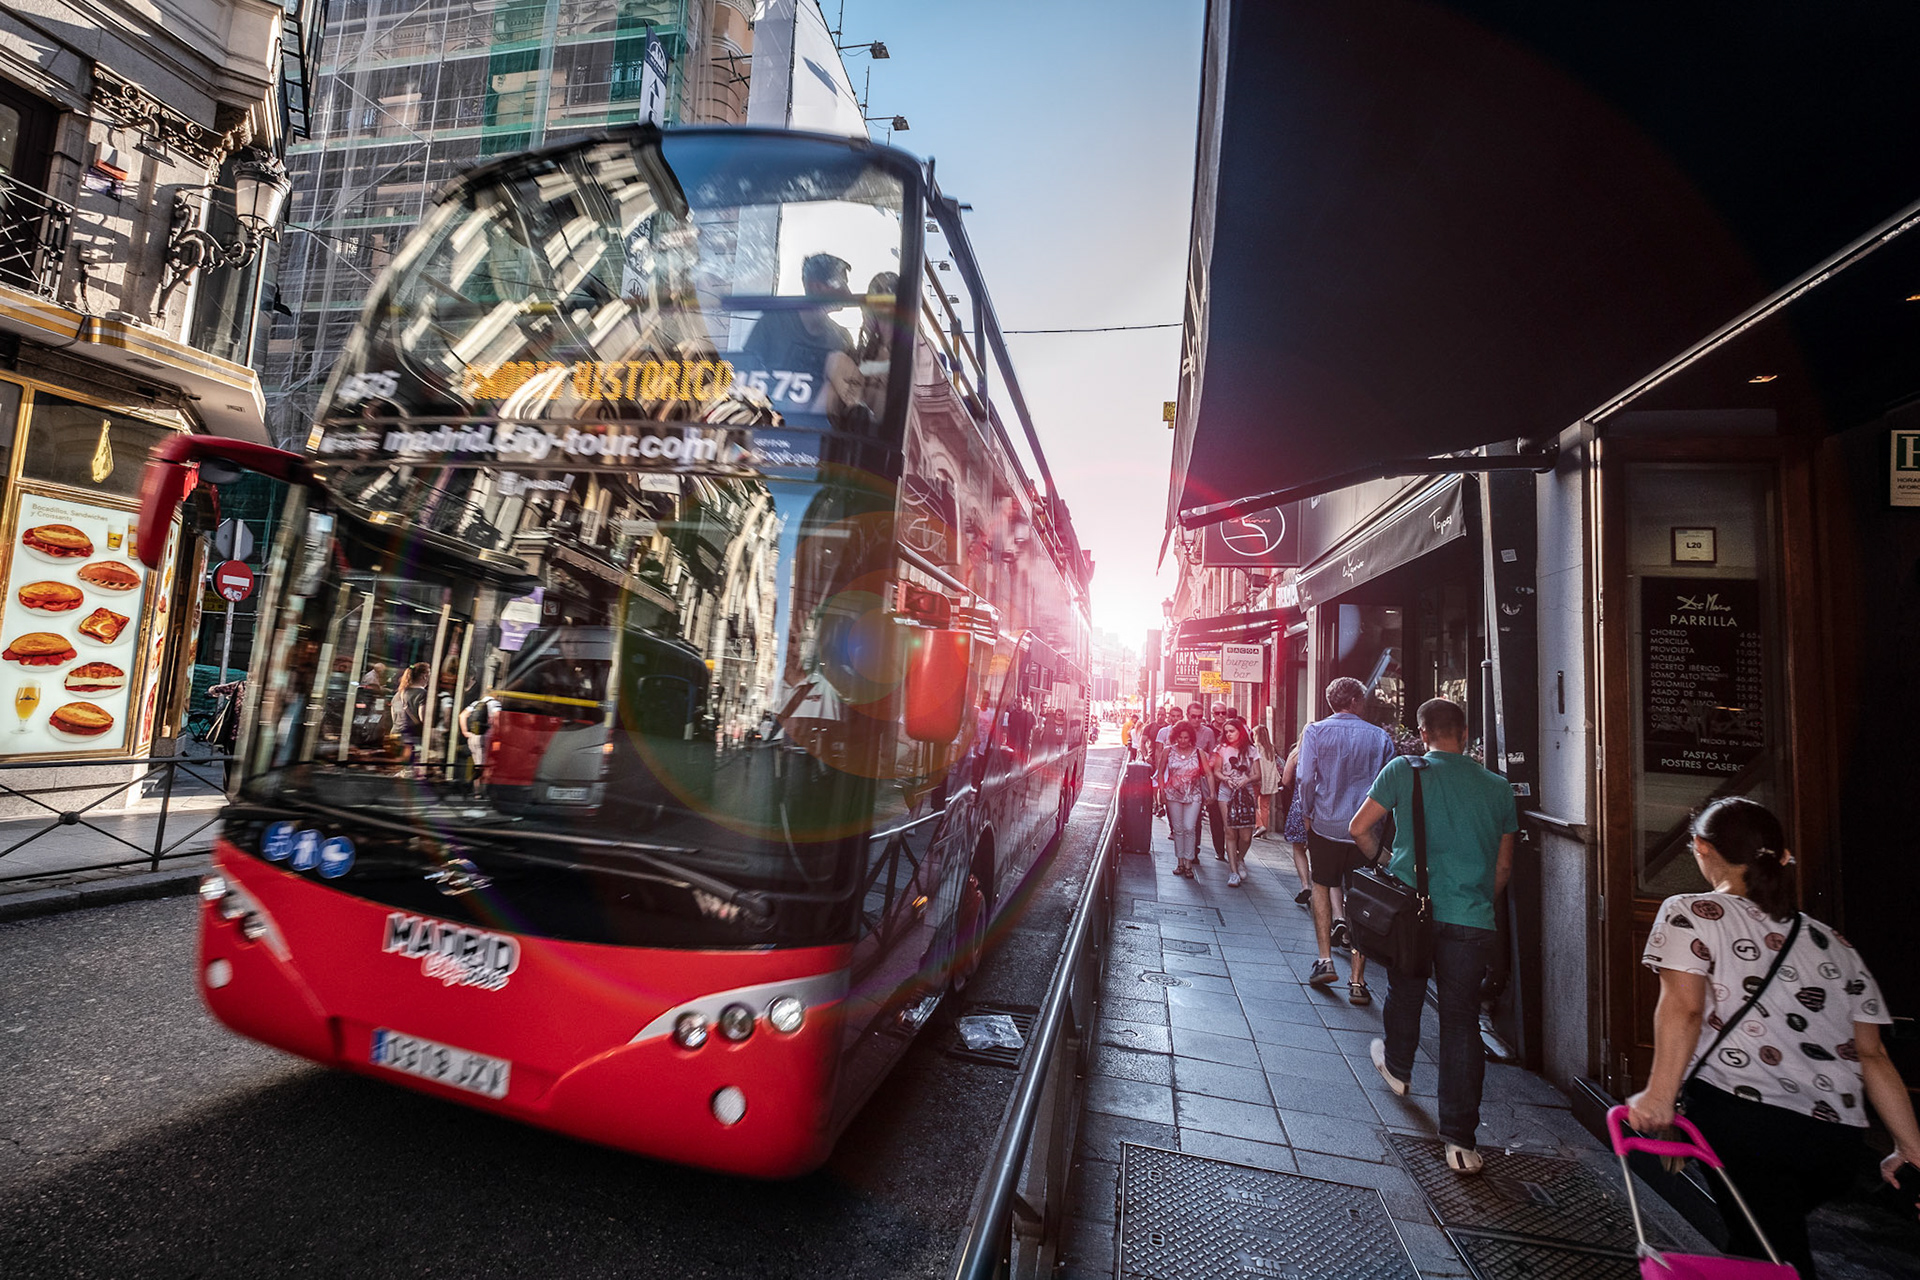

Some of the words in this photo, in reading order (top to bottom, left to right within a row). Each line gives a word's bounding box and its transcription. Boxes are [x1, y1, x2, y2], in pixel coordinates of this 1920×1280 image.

[573, 360, 734, 401] HISTORICO
[37, 511, 73, 522] Croissants
[70, 510, 109, 522] Sandwiches
[1669, 614, 1738, 628] PARRILLA
[1650, 629, 1688, 637] CHORIZO
[1226, 647, 1260, 655] BACOA
[1650, 646, 1695, 654] PROVOLETA
[1226, 656, 1259, 669] burger
[1650, 663, 1685, 671] SECRETO
[1175, 665, 1199, 675] COFFEE
[1233, 669, 1251, 679] bar
[1650, 671, 1676, 679] LOMO
[1650, 680, 1697, 689] SOLOMILLO
[1650, 689, 1680, 697] ASADO
[1697, 690, 1715, 698] TIRA
[1650, 697, 1677, 705] POLLO
[1682, 750, 1719, 760] PASTAS
[1723, 753, 1730, 761] Y
[1661, 758, 1702, 769] POSTRES
